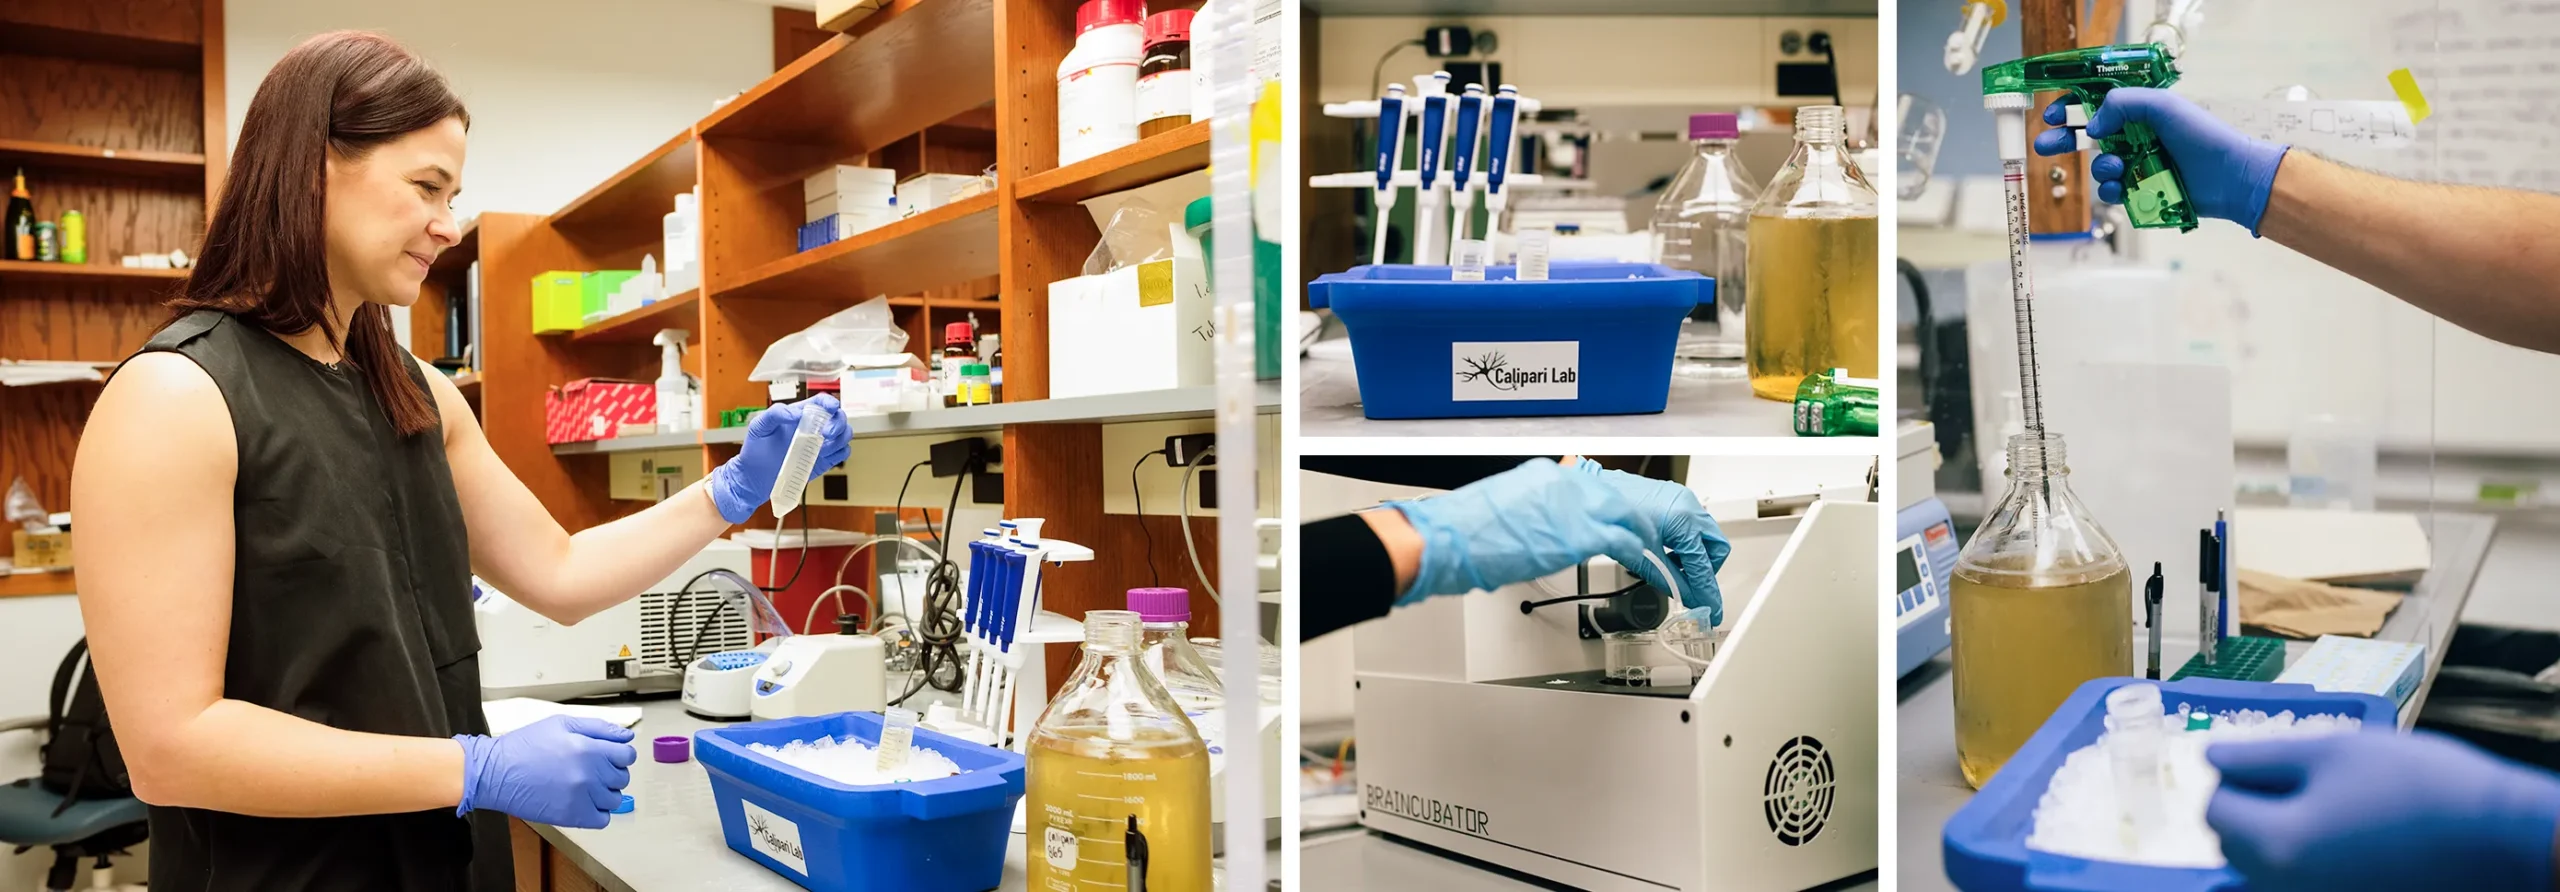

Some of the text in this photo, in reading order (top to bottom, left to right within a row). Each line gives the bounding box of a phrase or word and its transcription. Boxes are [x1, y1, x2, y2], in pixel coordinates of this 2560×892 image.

[2096, 64, 2129, 72] Thermo
[1495, 366, 1577, 387] Calipari Lab
[1366, 783, 1489, 836] BRAINCUBATOR
[764, 829, 804, 860] Calipari Lab
